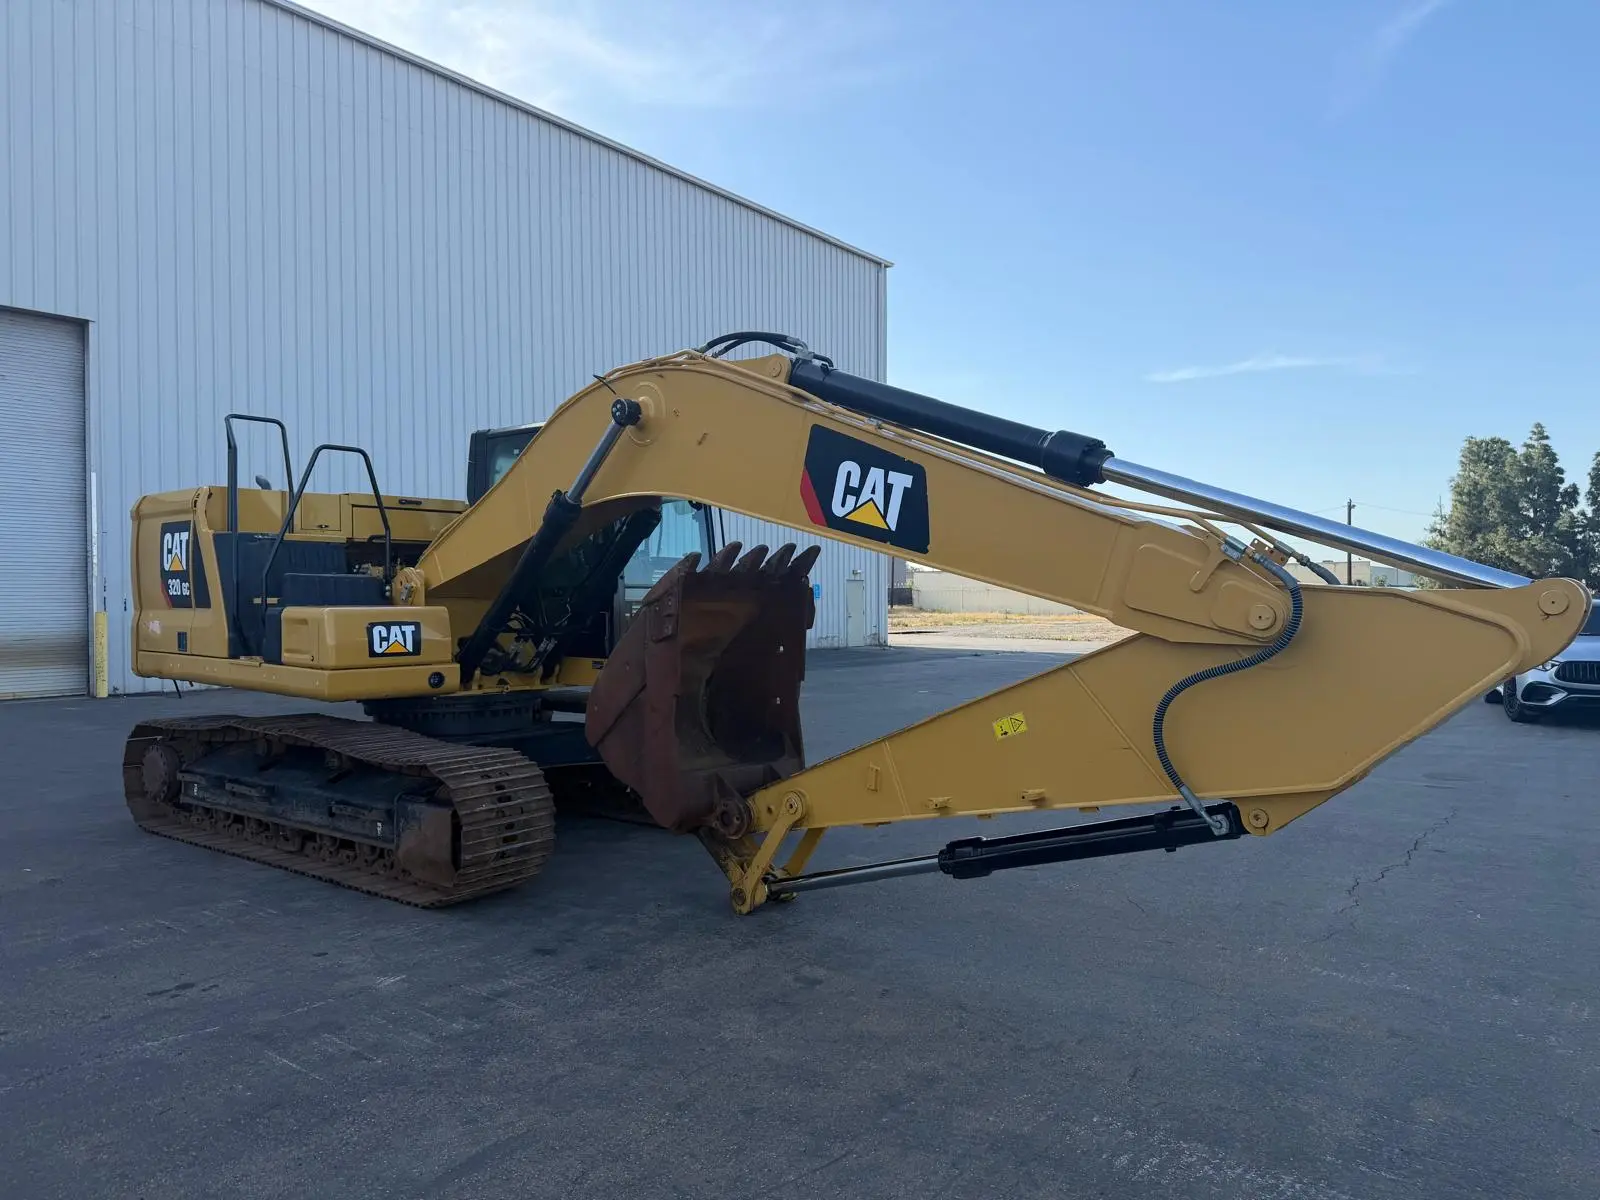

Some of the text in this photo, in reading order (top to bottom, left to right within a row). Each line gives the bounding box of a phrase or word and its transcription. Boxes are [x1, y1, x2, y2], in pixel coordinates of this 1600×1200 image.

[831, 460, 914, 532] CAT
[163, 531, 189, 572] CAT
[168, 579, 190, 596] 320 GC
[372, 625, 416, 654] CAT
